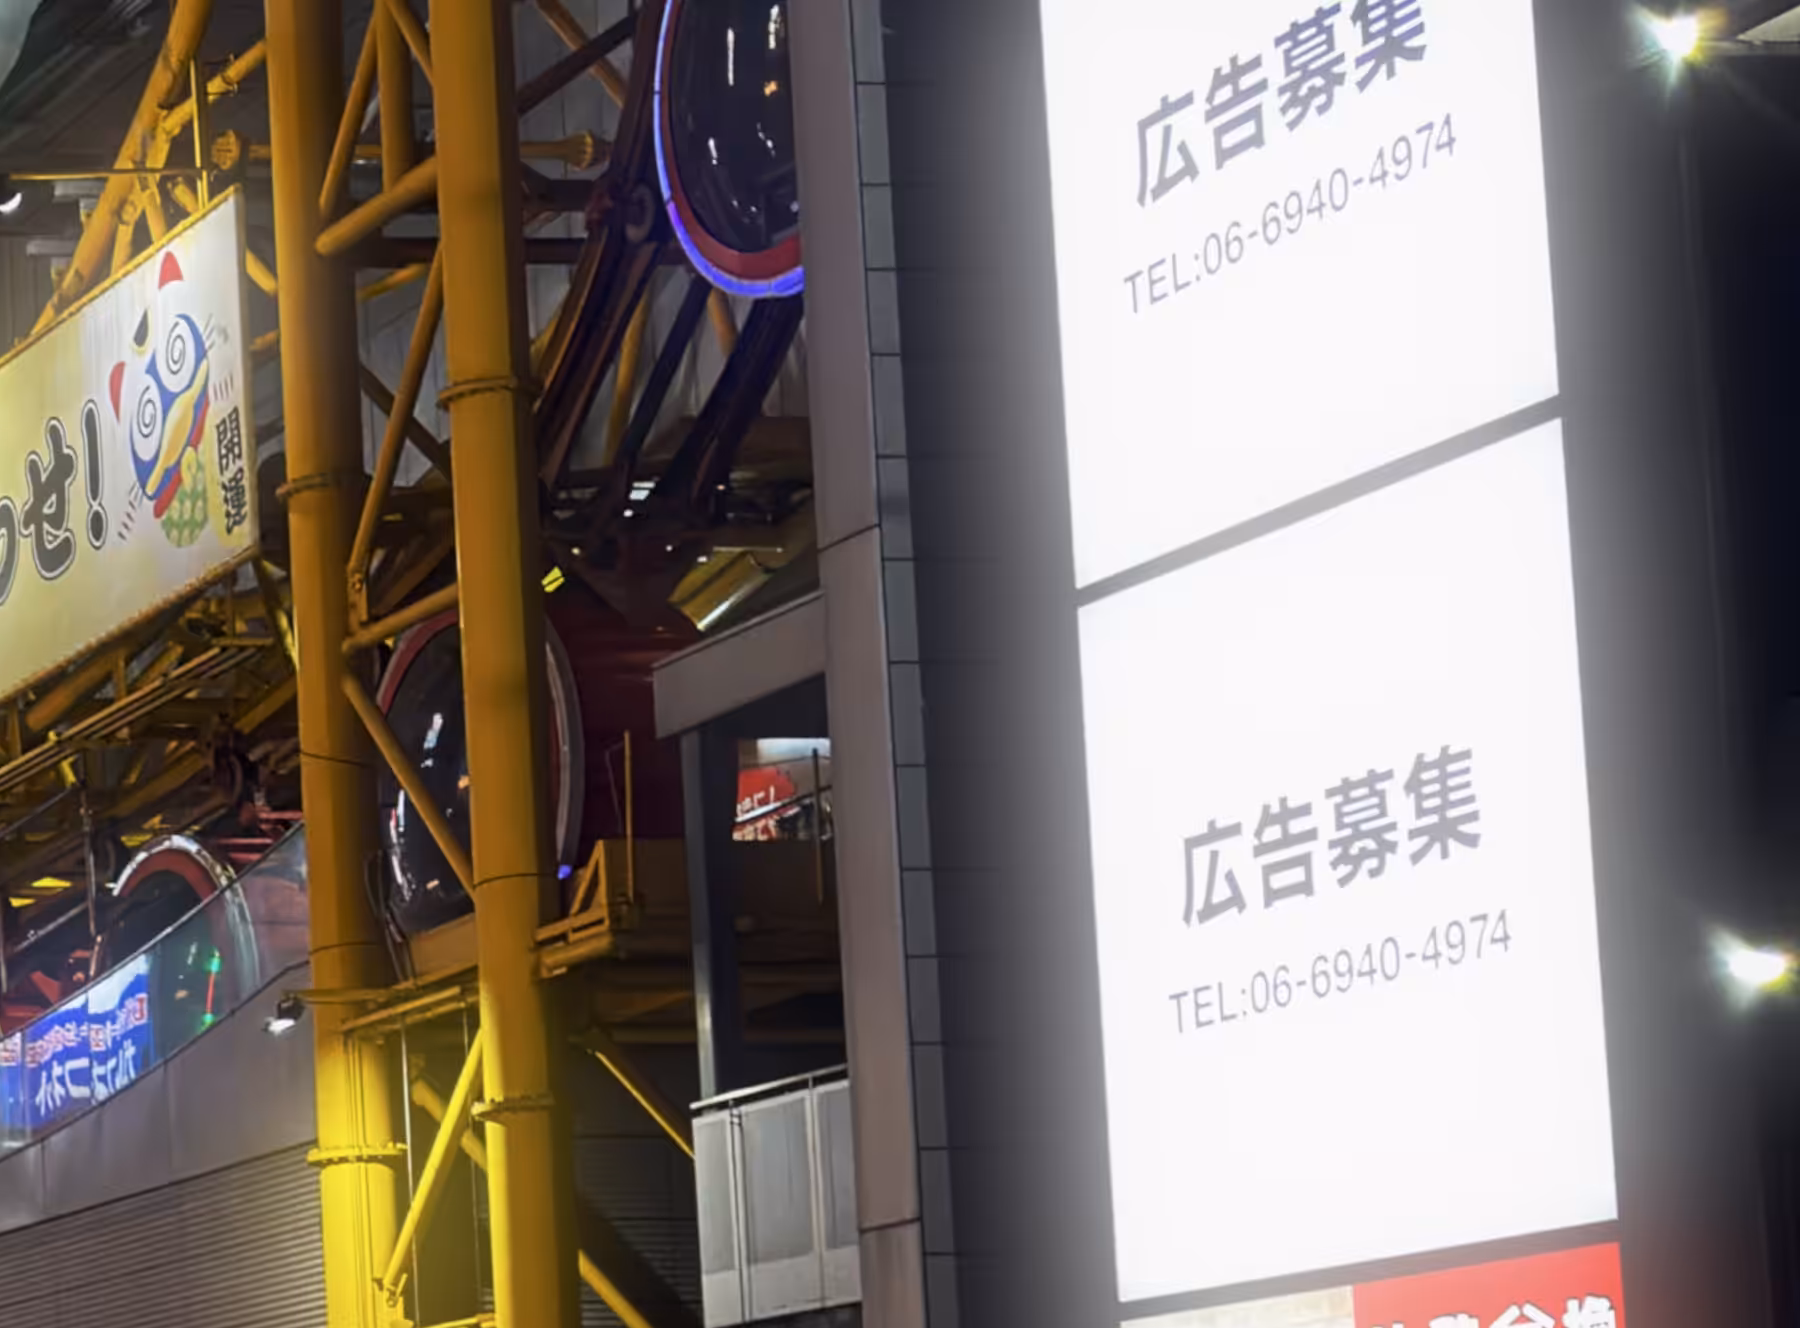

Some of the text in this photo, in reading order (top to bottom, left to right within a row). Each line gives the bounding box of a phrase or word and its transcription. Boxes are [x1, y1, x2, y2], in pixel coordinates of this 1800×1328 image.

[1135, 0, 1428, 208] 広告募集
[1122, 112, 1458, 315] TEL:06-6940-4974
[1180, 744, 1482, 929] 広告募集
[1167, 908, 1513, 1035] TEL:06-6940-4974
